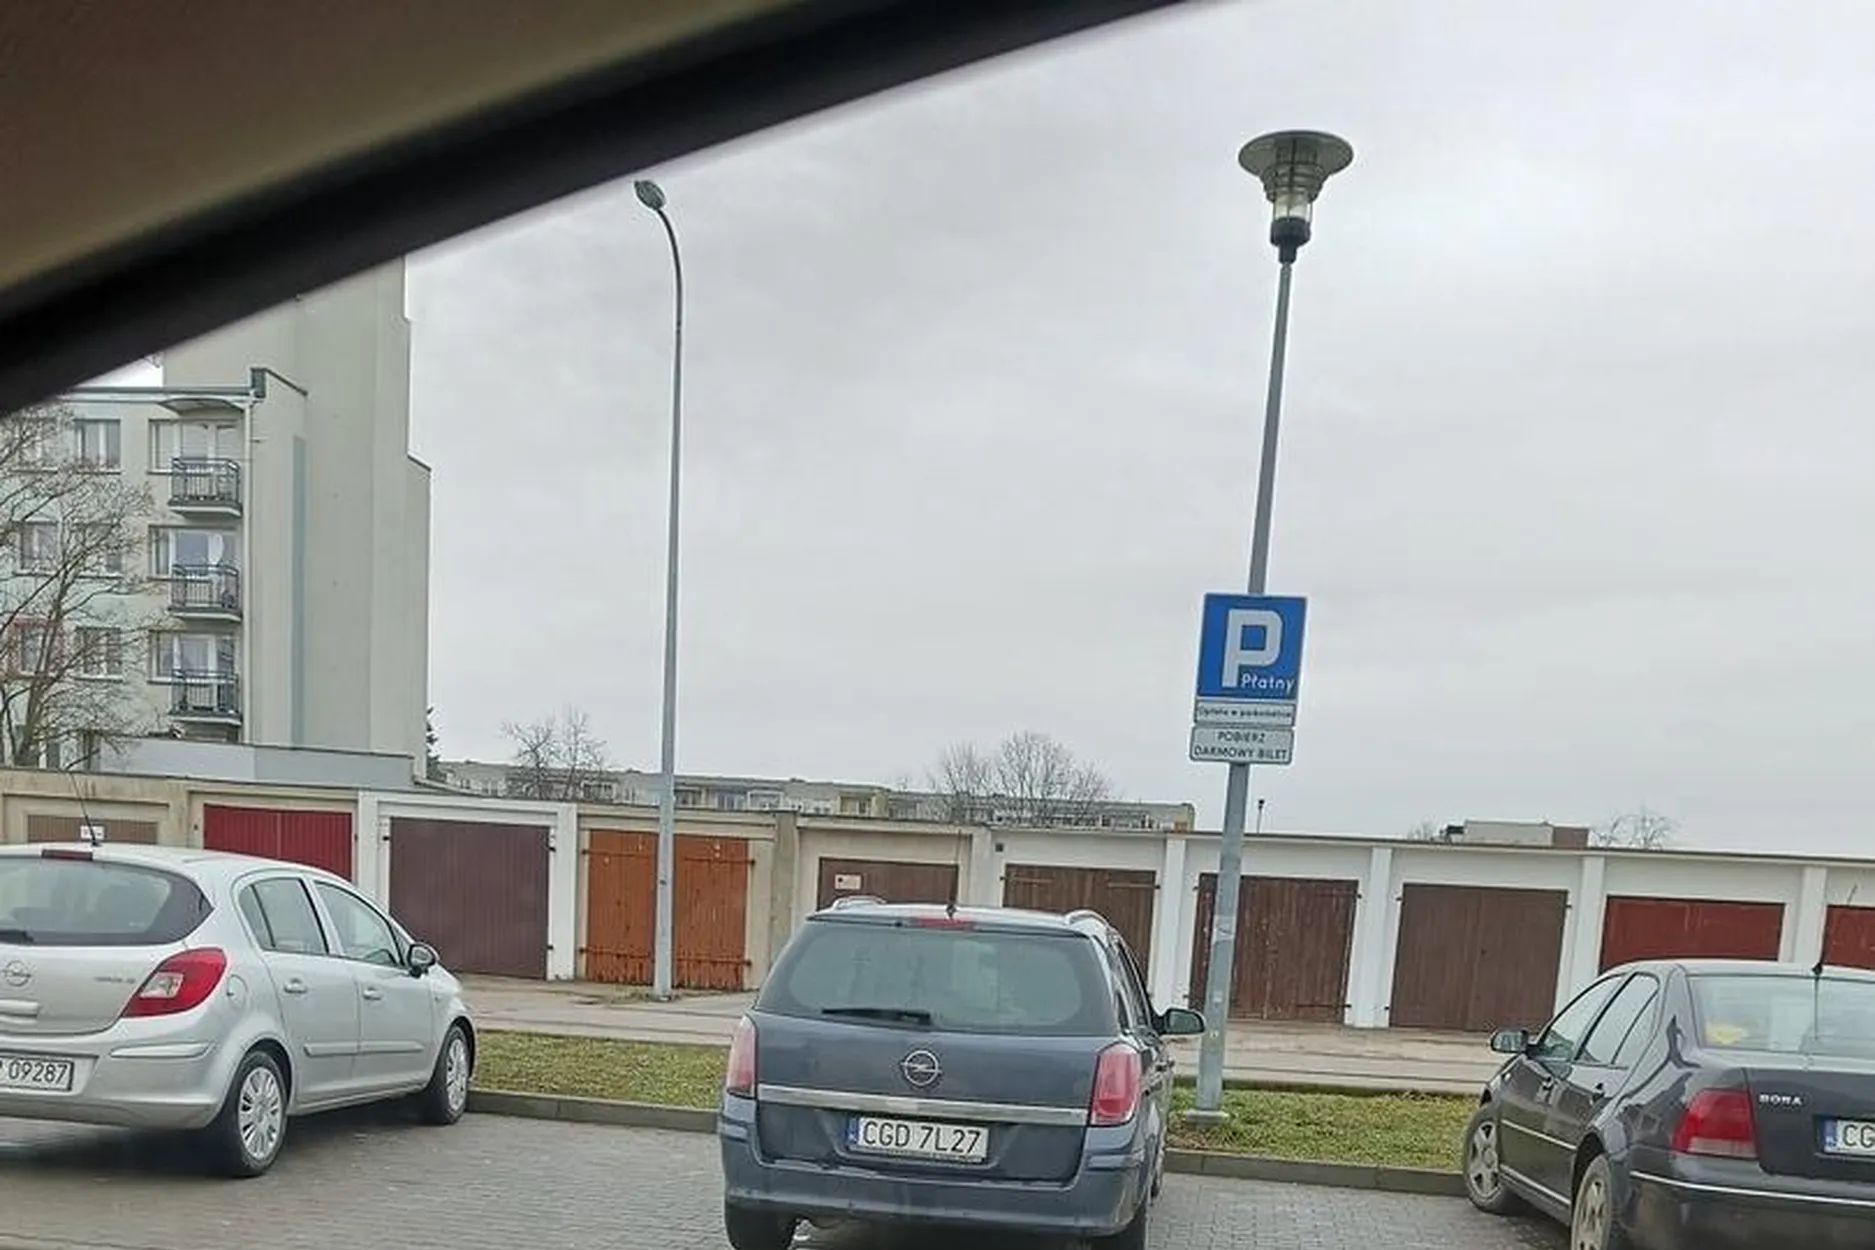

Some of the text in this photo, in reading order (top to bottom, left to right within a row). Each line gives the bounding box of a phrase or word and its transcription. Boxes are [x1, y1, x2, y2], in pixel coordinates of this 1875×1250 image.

[1222, 609, 1283, 688] P
[1240, 672, 1296, 695] Płatny
[1217, 731, 1266, 743] POBIERZ
[1194, 744, 1288, 760] DARMOWY BILET
[8, 1060, 68, 1084] 09287
[1758, 1093, 1803, 1106] BORA
[863, 1120, 911, 1147] CGD
[919, 1125, 981, 1154] 7L27
